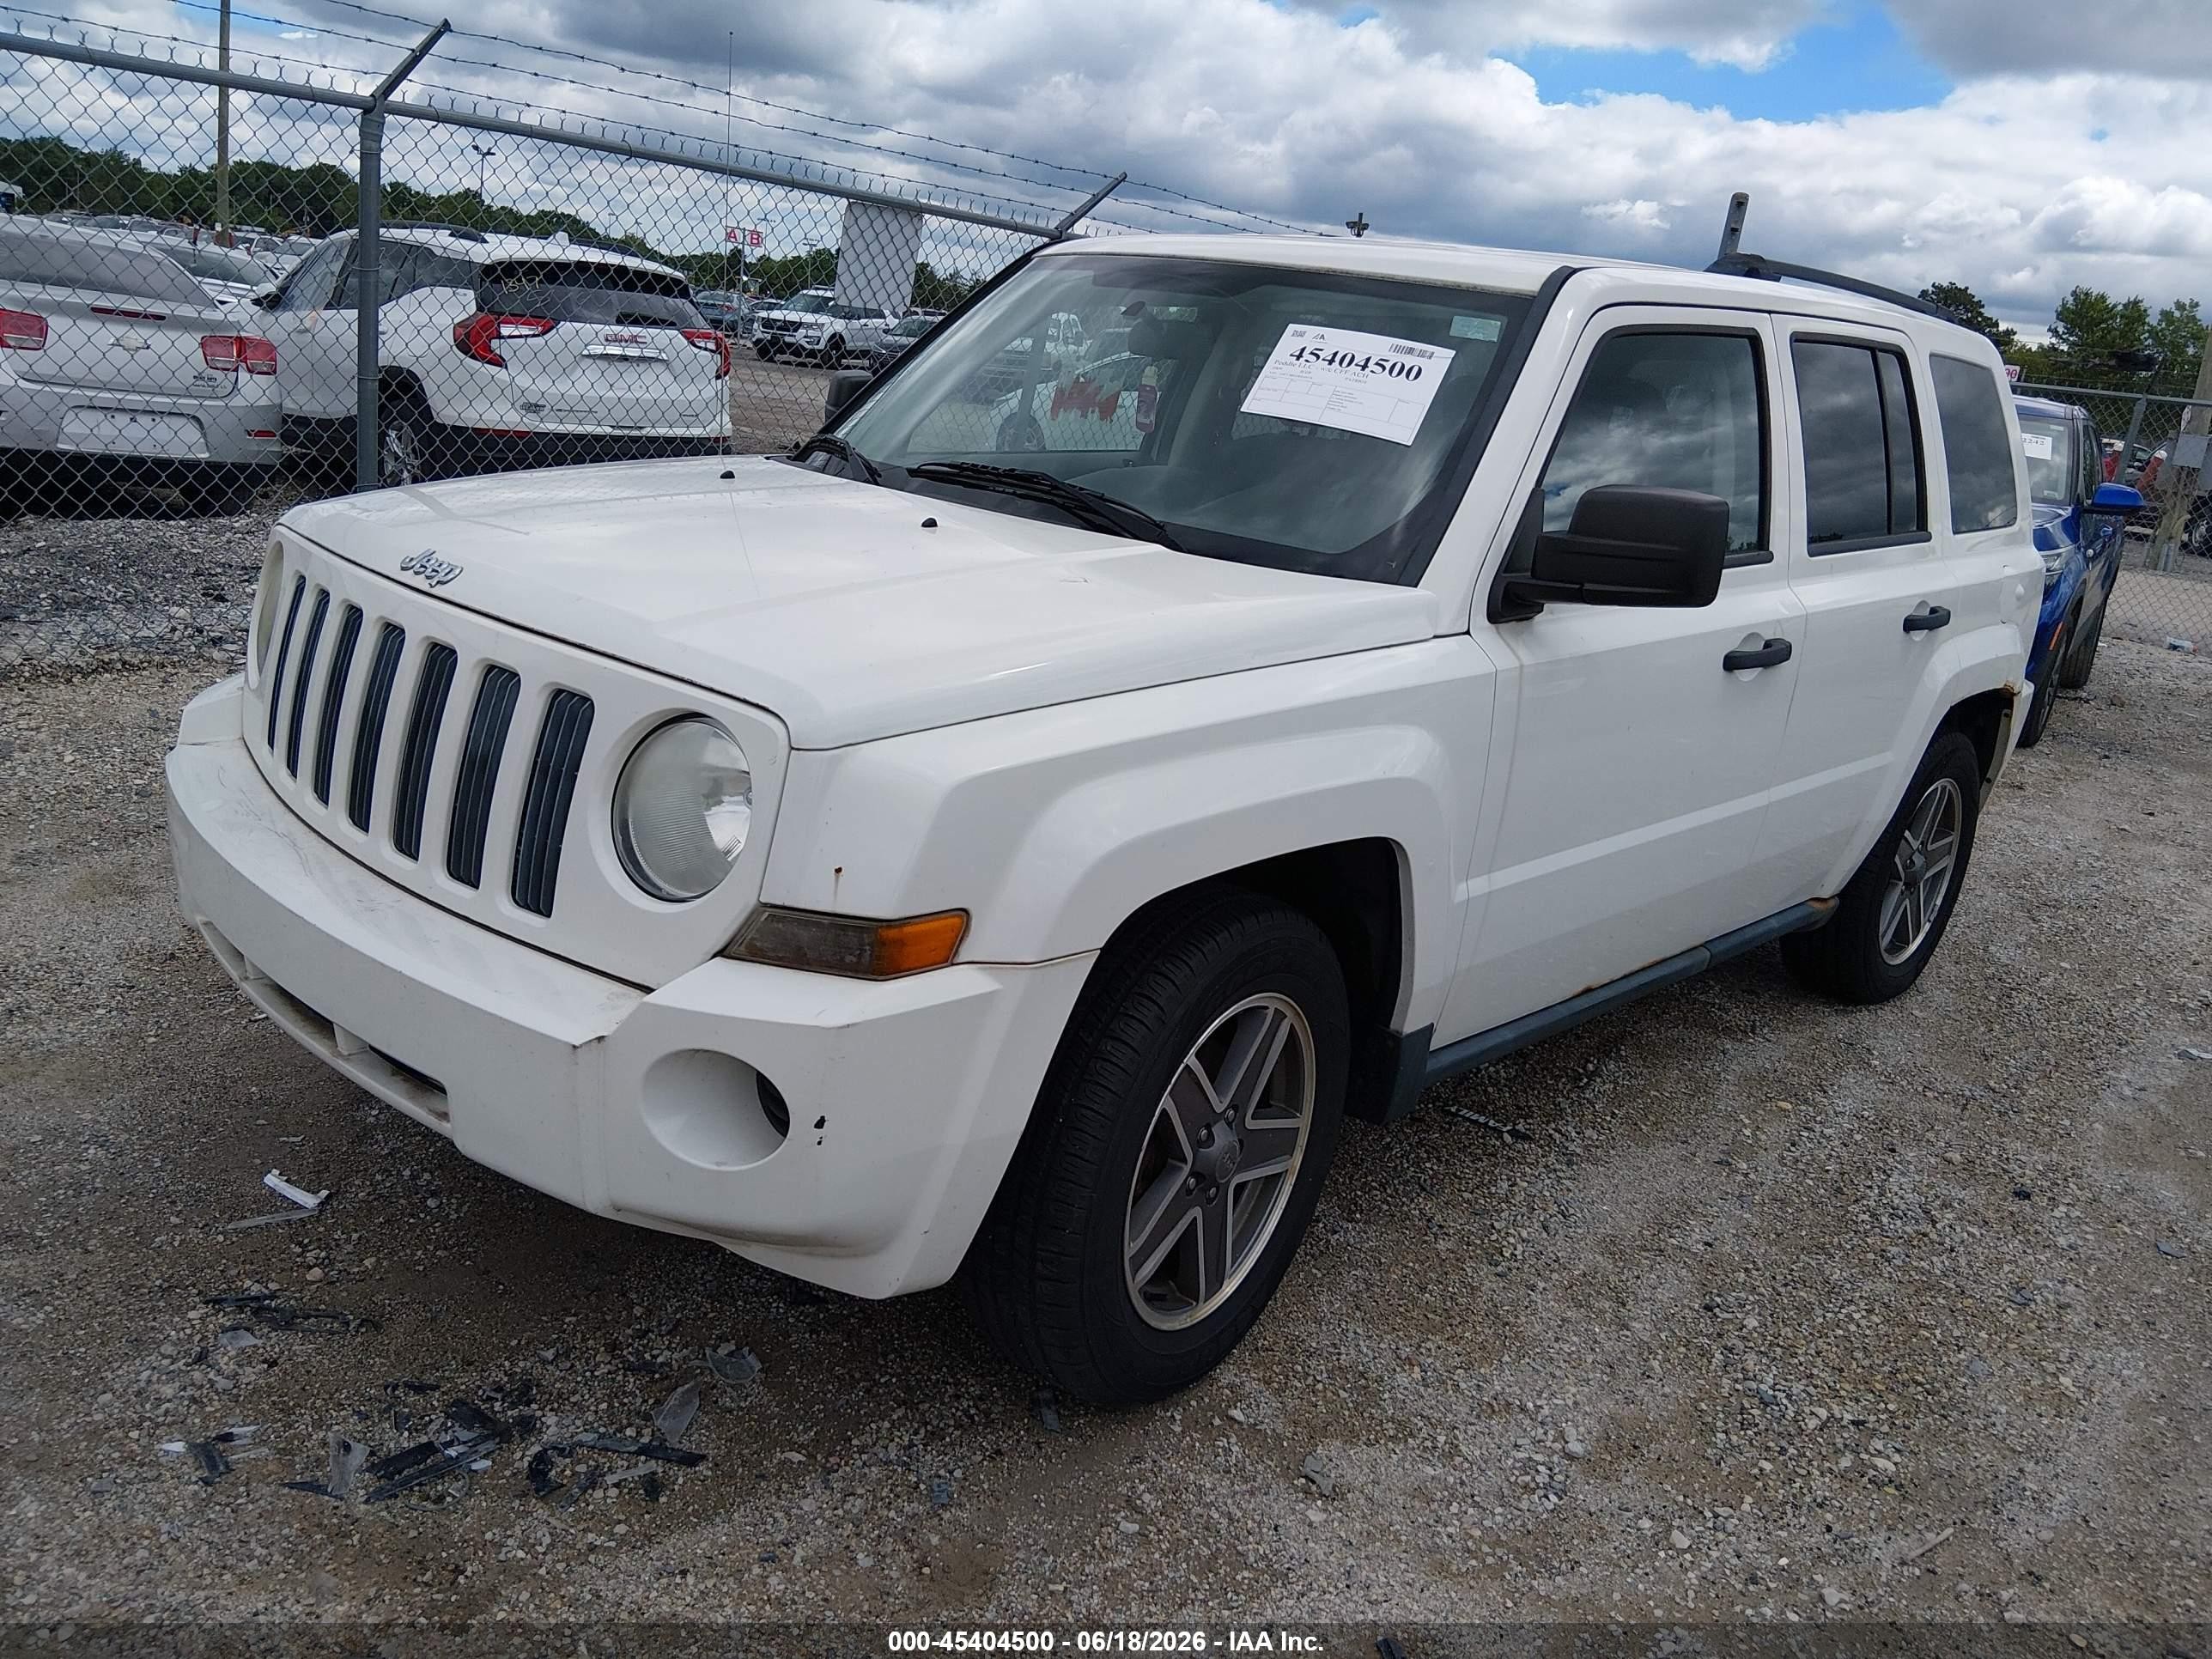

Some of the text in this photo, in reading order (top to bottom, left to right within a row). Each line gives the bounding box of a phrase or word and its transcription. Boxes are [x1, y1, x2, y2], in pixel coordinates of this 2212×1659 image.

[727, 228, 738, 241] A
[749, 233, 760, 244] B
[604, 333, 647, 345] GMC
[1289, 345, 1423, 382] 45404500
[400, 549, 464, 588] Jeep
